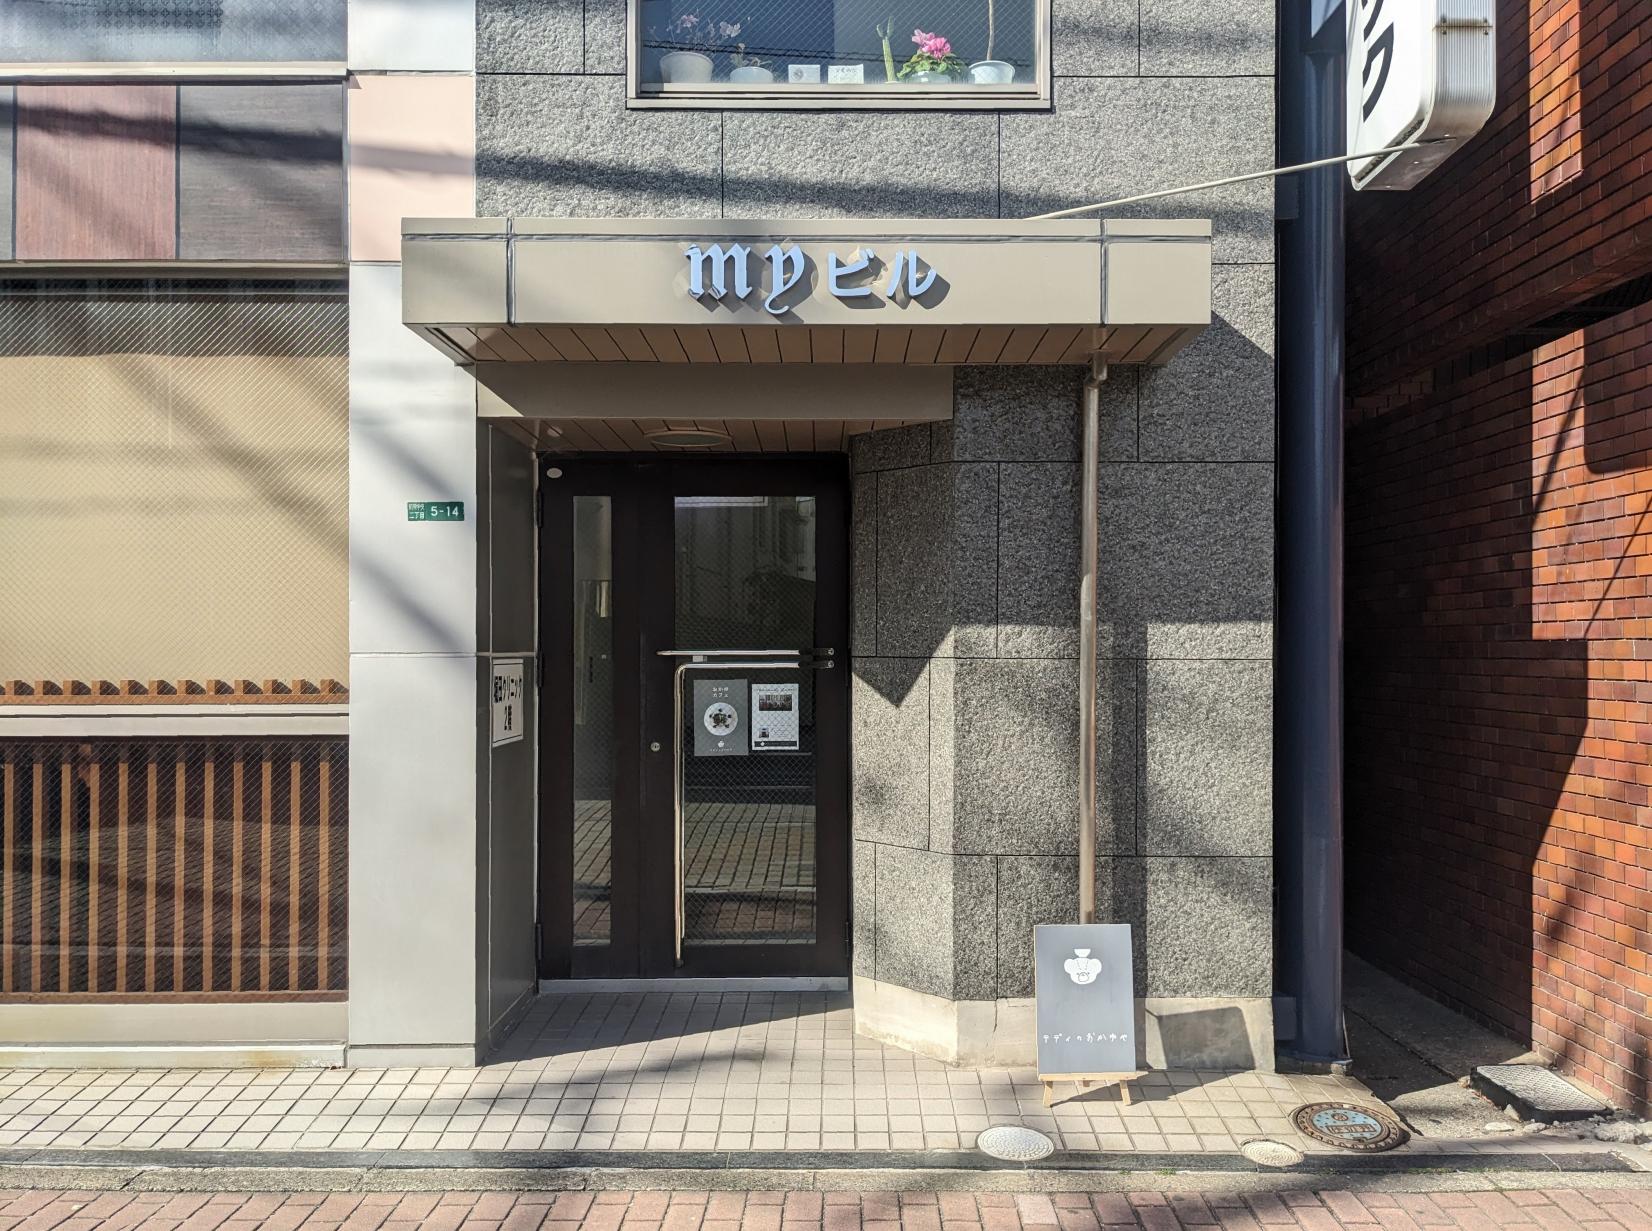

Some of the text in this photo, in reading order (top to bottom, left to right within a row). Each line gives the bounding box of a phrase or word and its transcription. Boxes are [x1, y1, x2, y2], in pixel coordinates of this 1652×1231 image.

[827, 247, 937, 297] ビル
[431, 506, 459, 517] 5-14
[1043, 1032, 1128, 1044] テディのおかゆや
